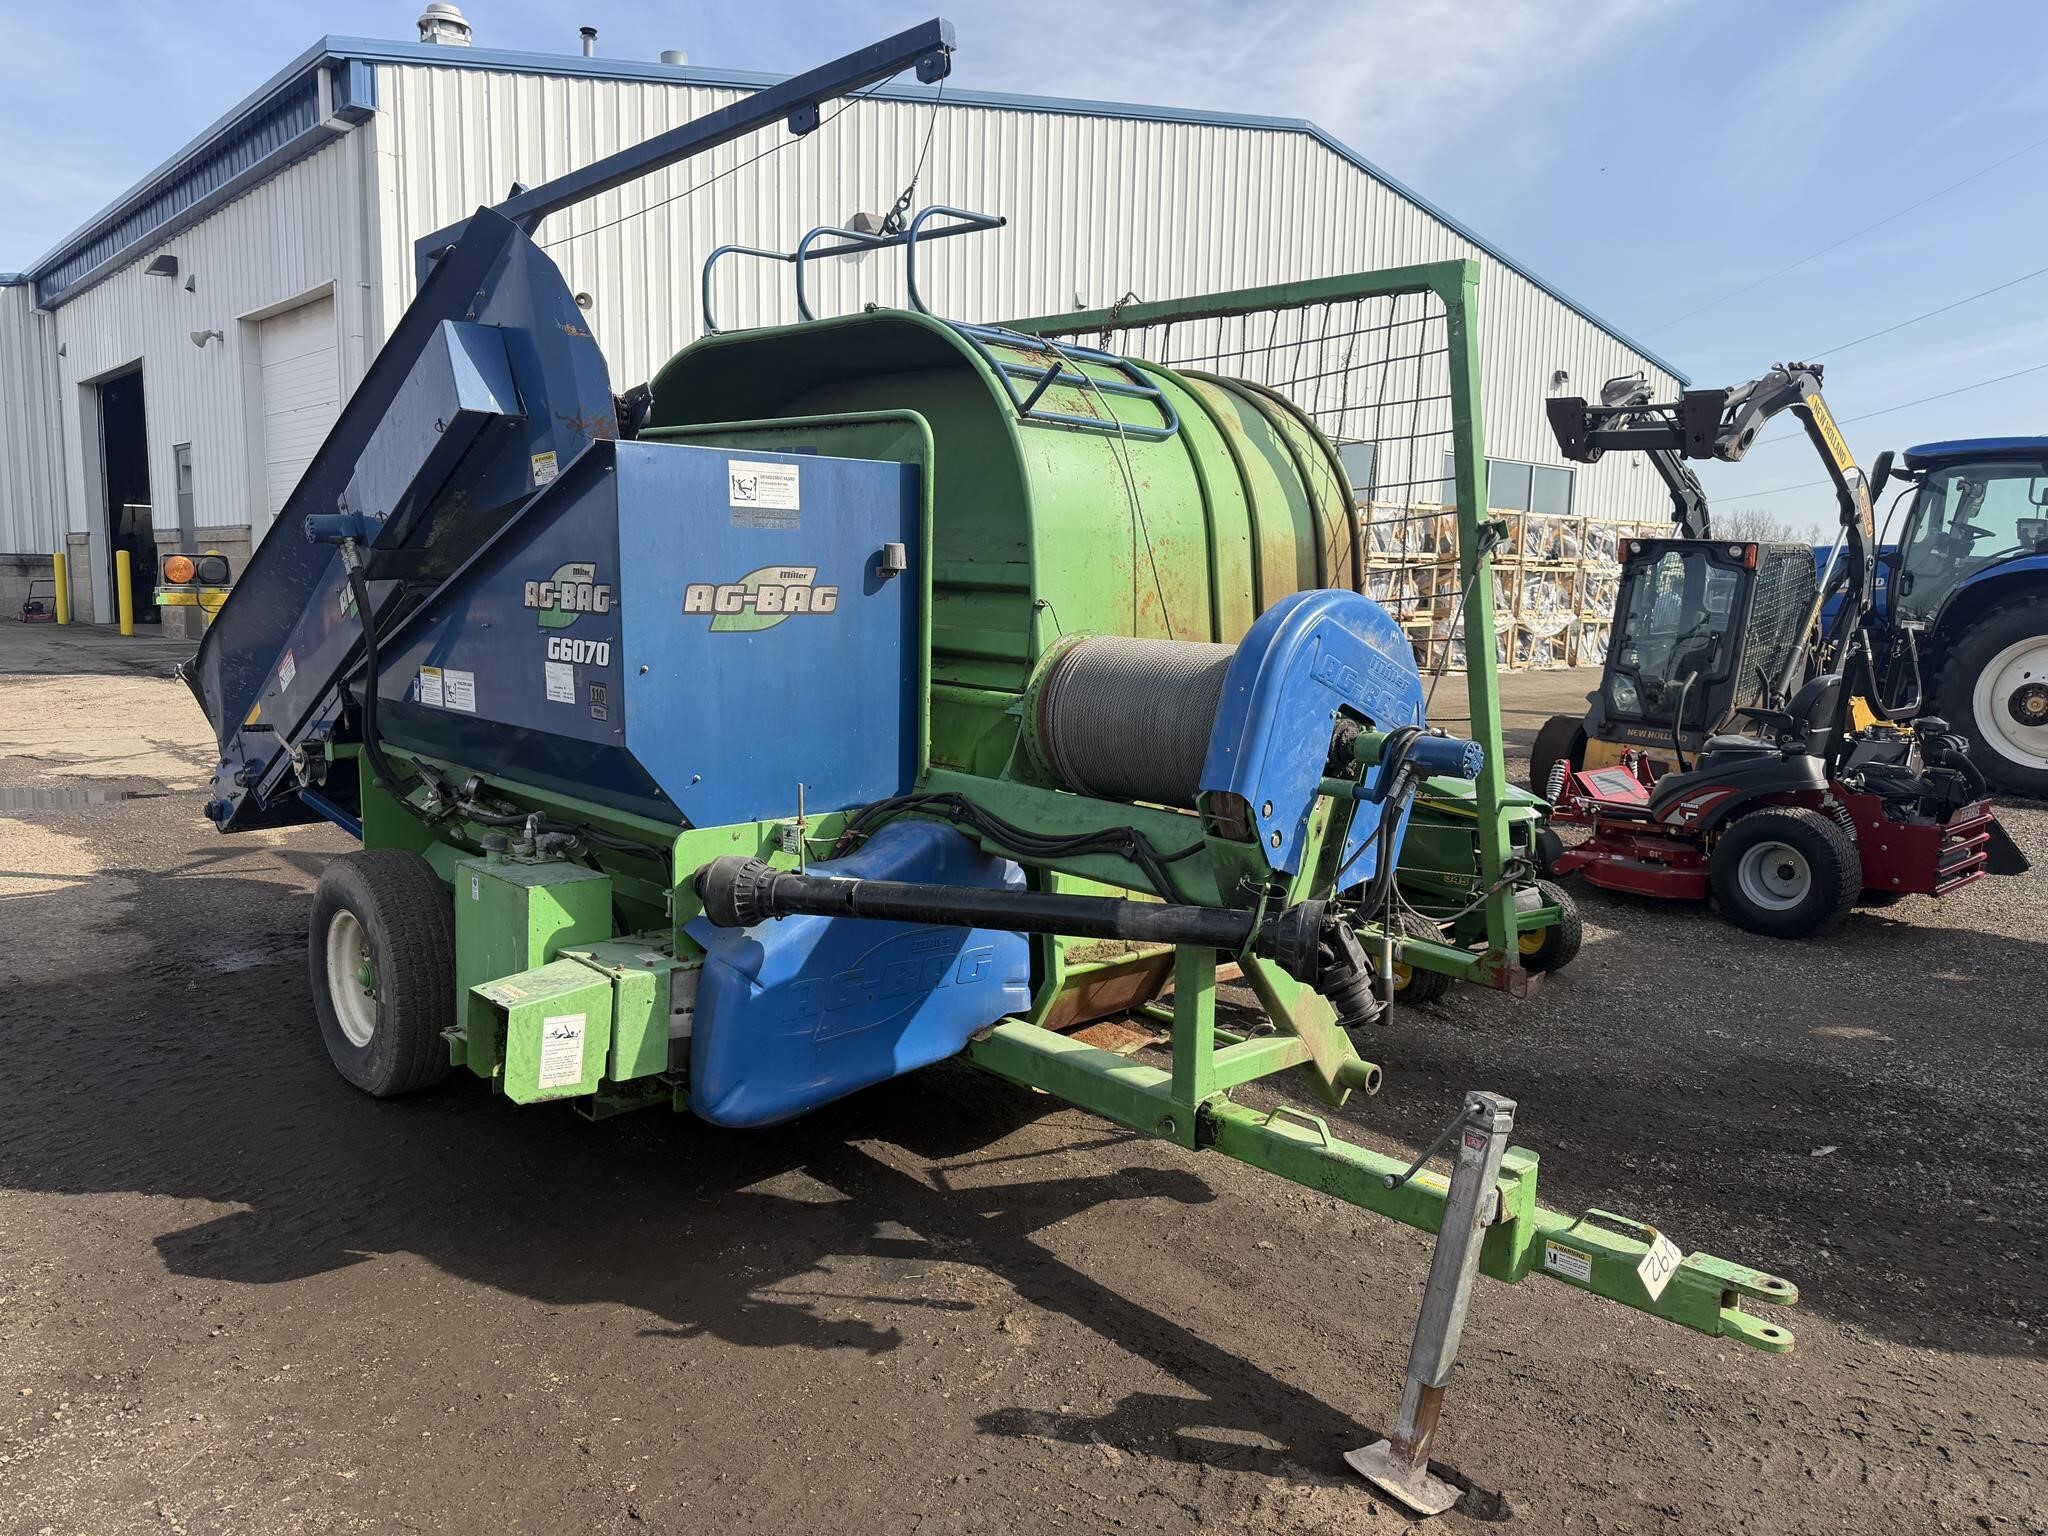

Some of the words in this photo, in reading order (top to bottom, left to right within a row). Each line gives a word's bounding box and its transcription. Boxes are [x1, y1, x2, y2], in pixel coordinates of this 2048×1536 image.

[1813, 399, 1827, 426] NEW
[1824, 420, 1847, 465] HOLLAND
[524, 580, 612, 614] AG-BAG
[683, 584, 839, 615] AG-BAG
[547, 636, 611, 667] G6070
[1626, 728, 1647, 738] NEW
[1648, 730, 1688, 742] HOLLD
[1557, 1244, 1586, 1260] WARNING
